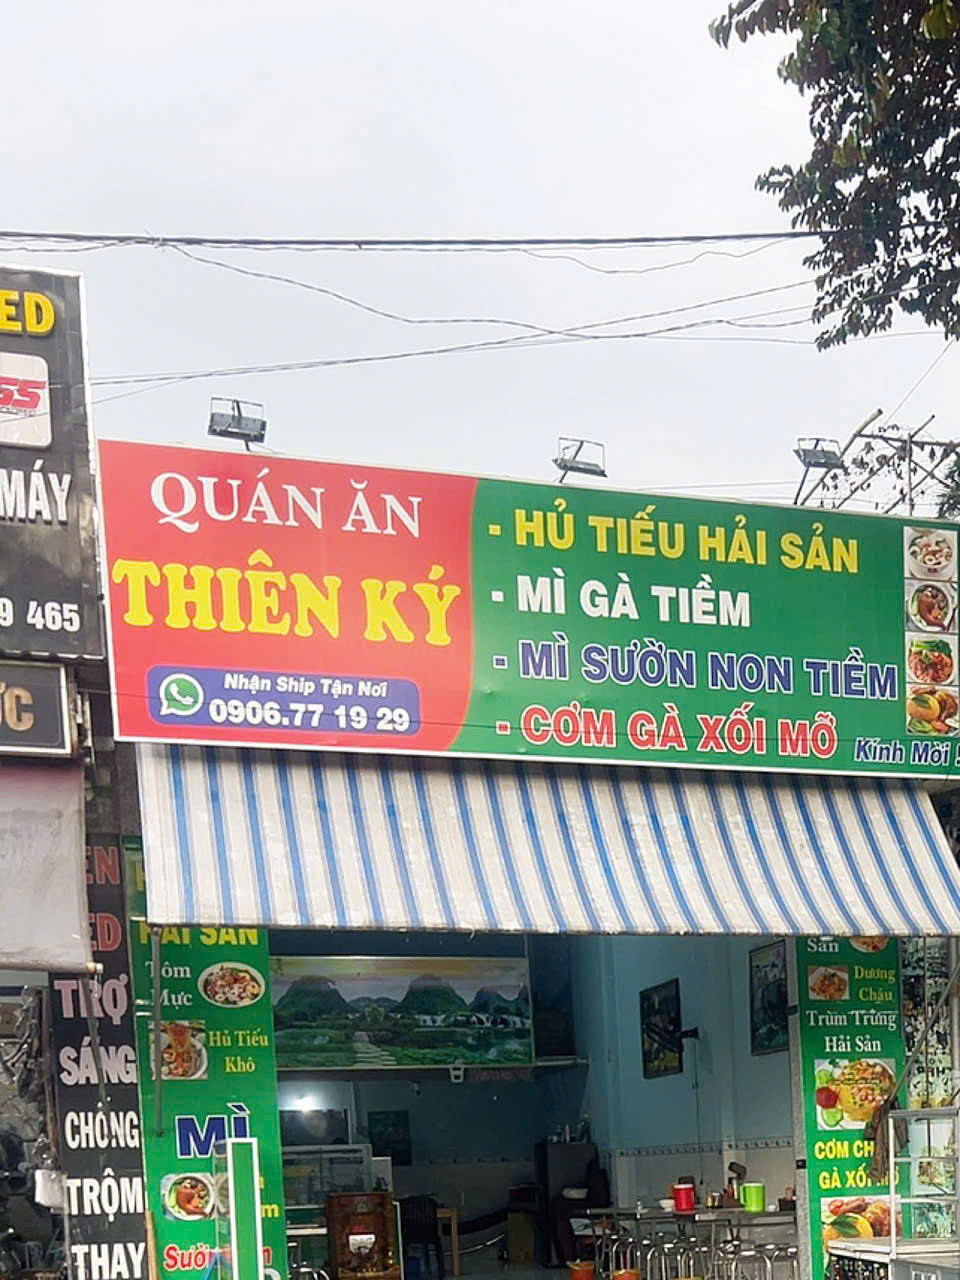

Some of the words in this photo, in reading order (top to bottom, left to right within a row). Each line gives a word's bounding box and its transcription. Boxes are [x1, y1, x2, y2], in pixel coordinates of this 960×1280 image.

[150, 467, 325, 534] QUÁN
[342, 477, 423, 539] ĂN
[514, 497, 575, 550] HỦ
[588, 504, 685, 560] TIẾU
[698, 513, 767, 566] HẢI
[780, 522, 859, 575] SẢN
[112, 548, 342, 638] THIÊN
[361, 564, 461, 647] KÝ
[516, 567, 567, 616] MÌ
[579, 572, 640, 621] GÀ
[651, 573, 751, 629] TIỀM
[26, 600, 80, 632] 465
[519, 631, 569, 681] MÌ
[581, 637, 697, 689] SƯỜN
[708, 652, 793, 696] NON
[805, 647, 899, 701] TIỀM
[224, 673, 273, 695] Nhận
[276, 675, 316, 697] Ship
[320, 678, 354, 699] Tận
[208, 697, 324, 728] 0906.77
[335, 703, 367, 730] 19
[375, 705, 411, 733] 29
[520, 701, 617, 749] CƠM
[627, 702, 690, 754] GÀ
[696, 702, 766, 755] XỐI
[778, 710, 839, 759] MỠ
[855, 736, 905, 764] Kính
[910, 742, 950, 767] Mời
[53, 973, 129, 1027] TRỢ
[208, 1028, 232, 1048] Hủ
[234, 1027, 269, 1048] Tiếu
[824, 1034, 851, 1053] Hải
[855, 1034, 882, 1053] Sản
[224, 1055, 256, 1073] Khô
[814, 1138, 849, 1159] CƠM
[819, 1166, 842, 1190] GÀ
[67, 1175, 144, 1220] TRỘM
